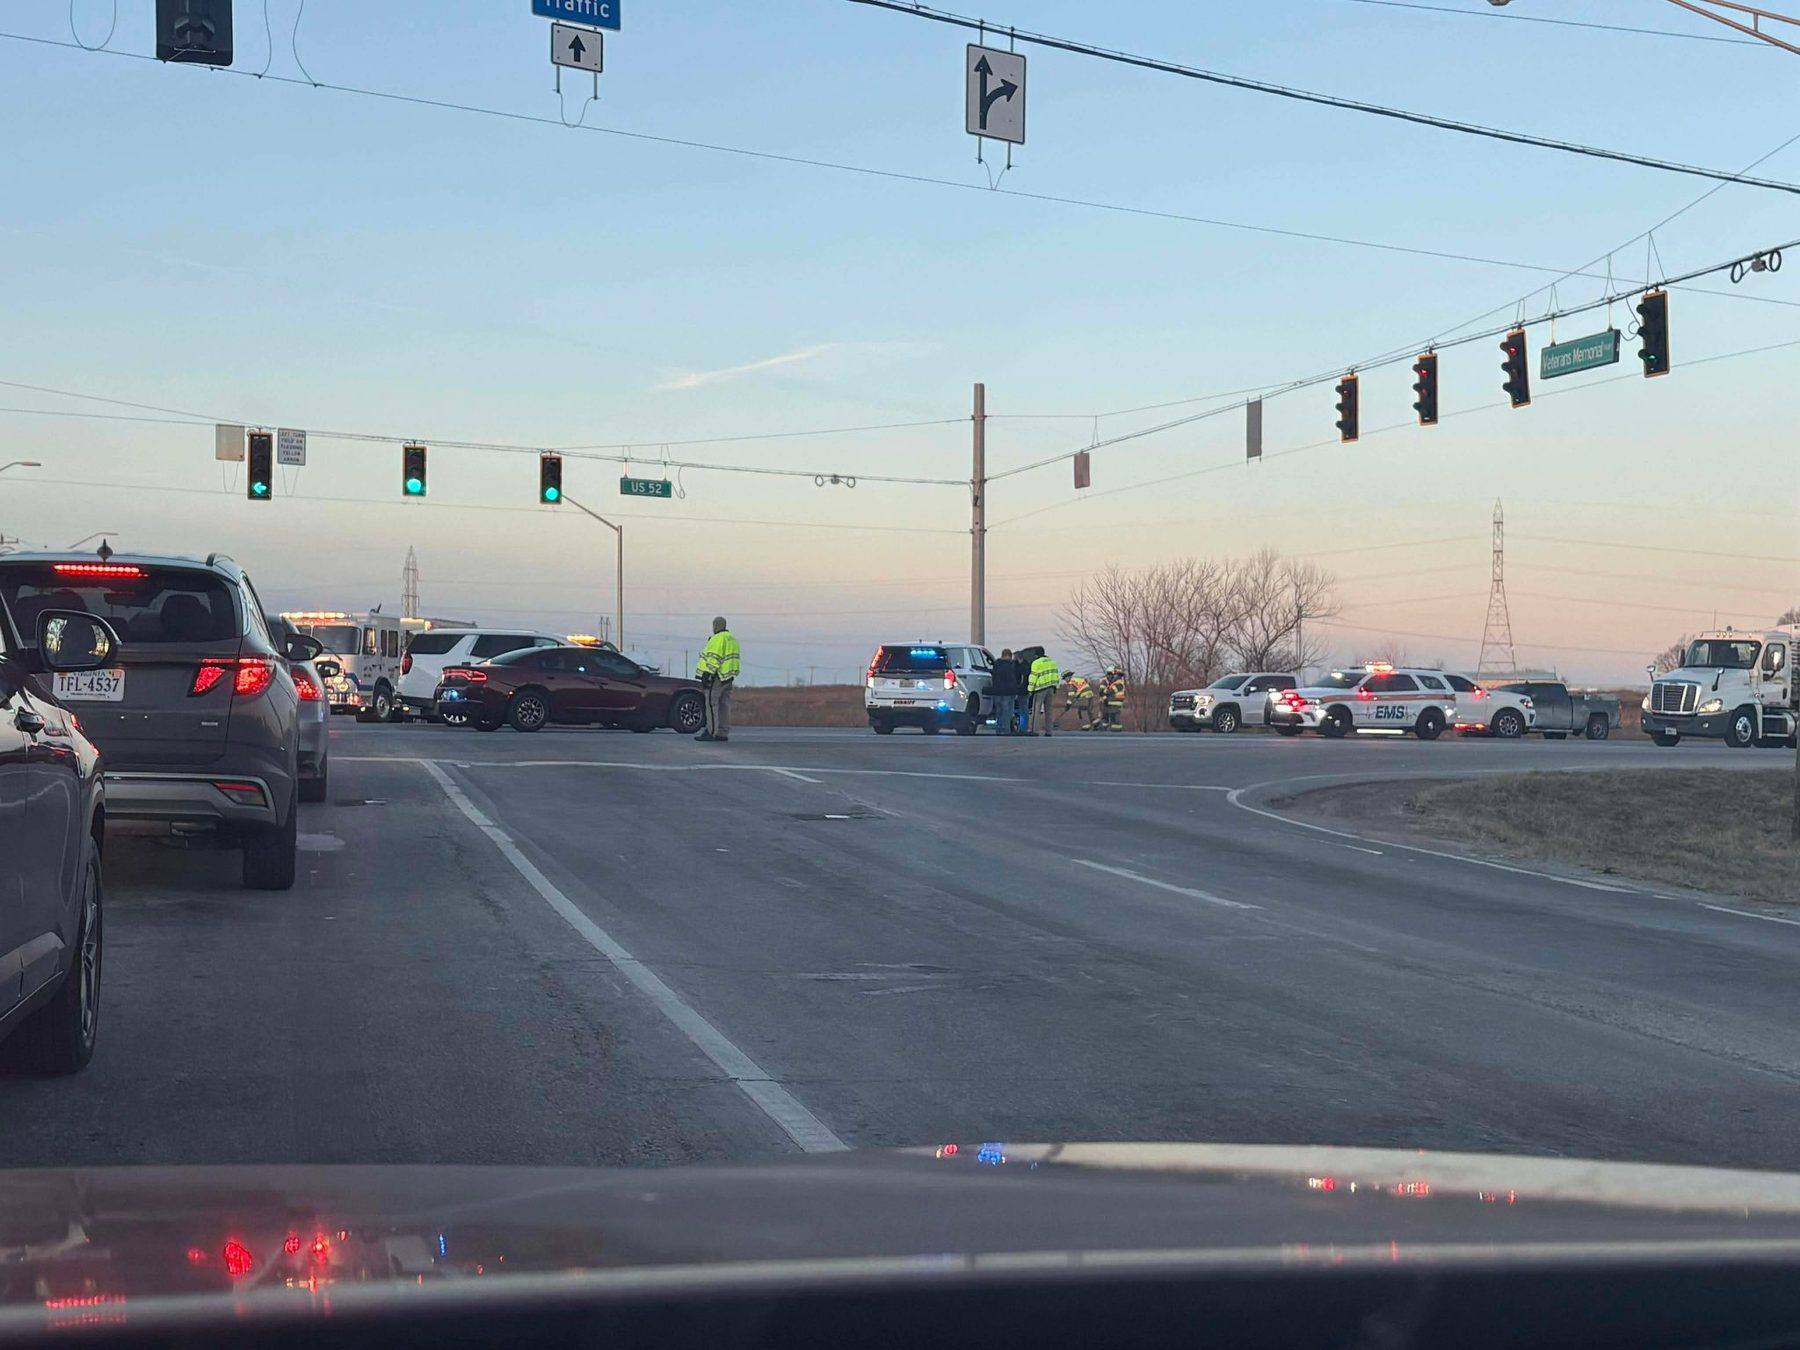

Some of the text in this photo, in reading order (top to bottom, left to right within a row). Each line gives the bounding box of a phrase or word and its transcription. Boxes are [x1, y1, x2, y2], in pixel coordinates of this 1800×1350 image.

[1543, 352, 1571, 371] Veterans
[632, 481, 662, 494] US 52
[60, 676, 120, 692] TFL-4537
[1375, 705, 1405, 719] EMS
